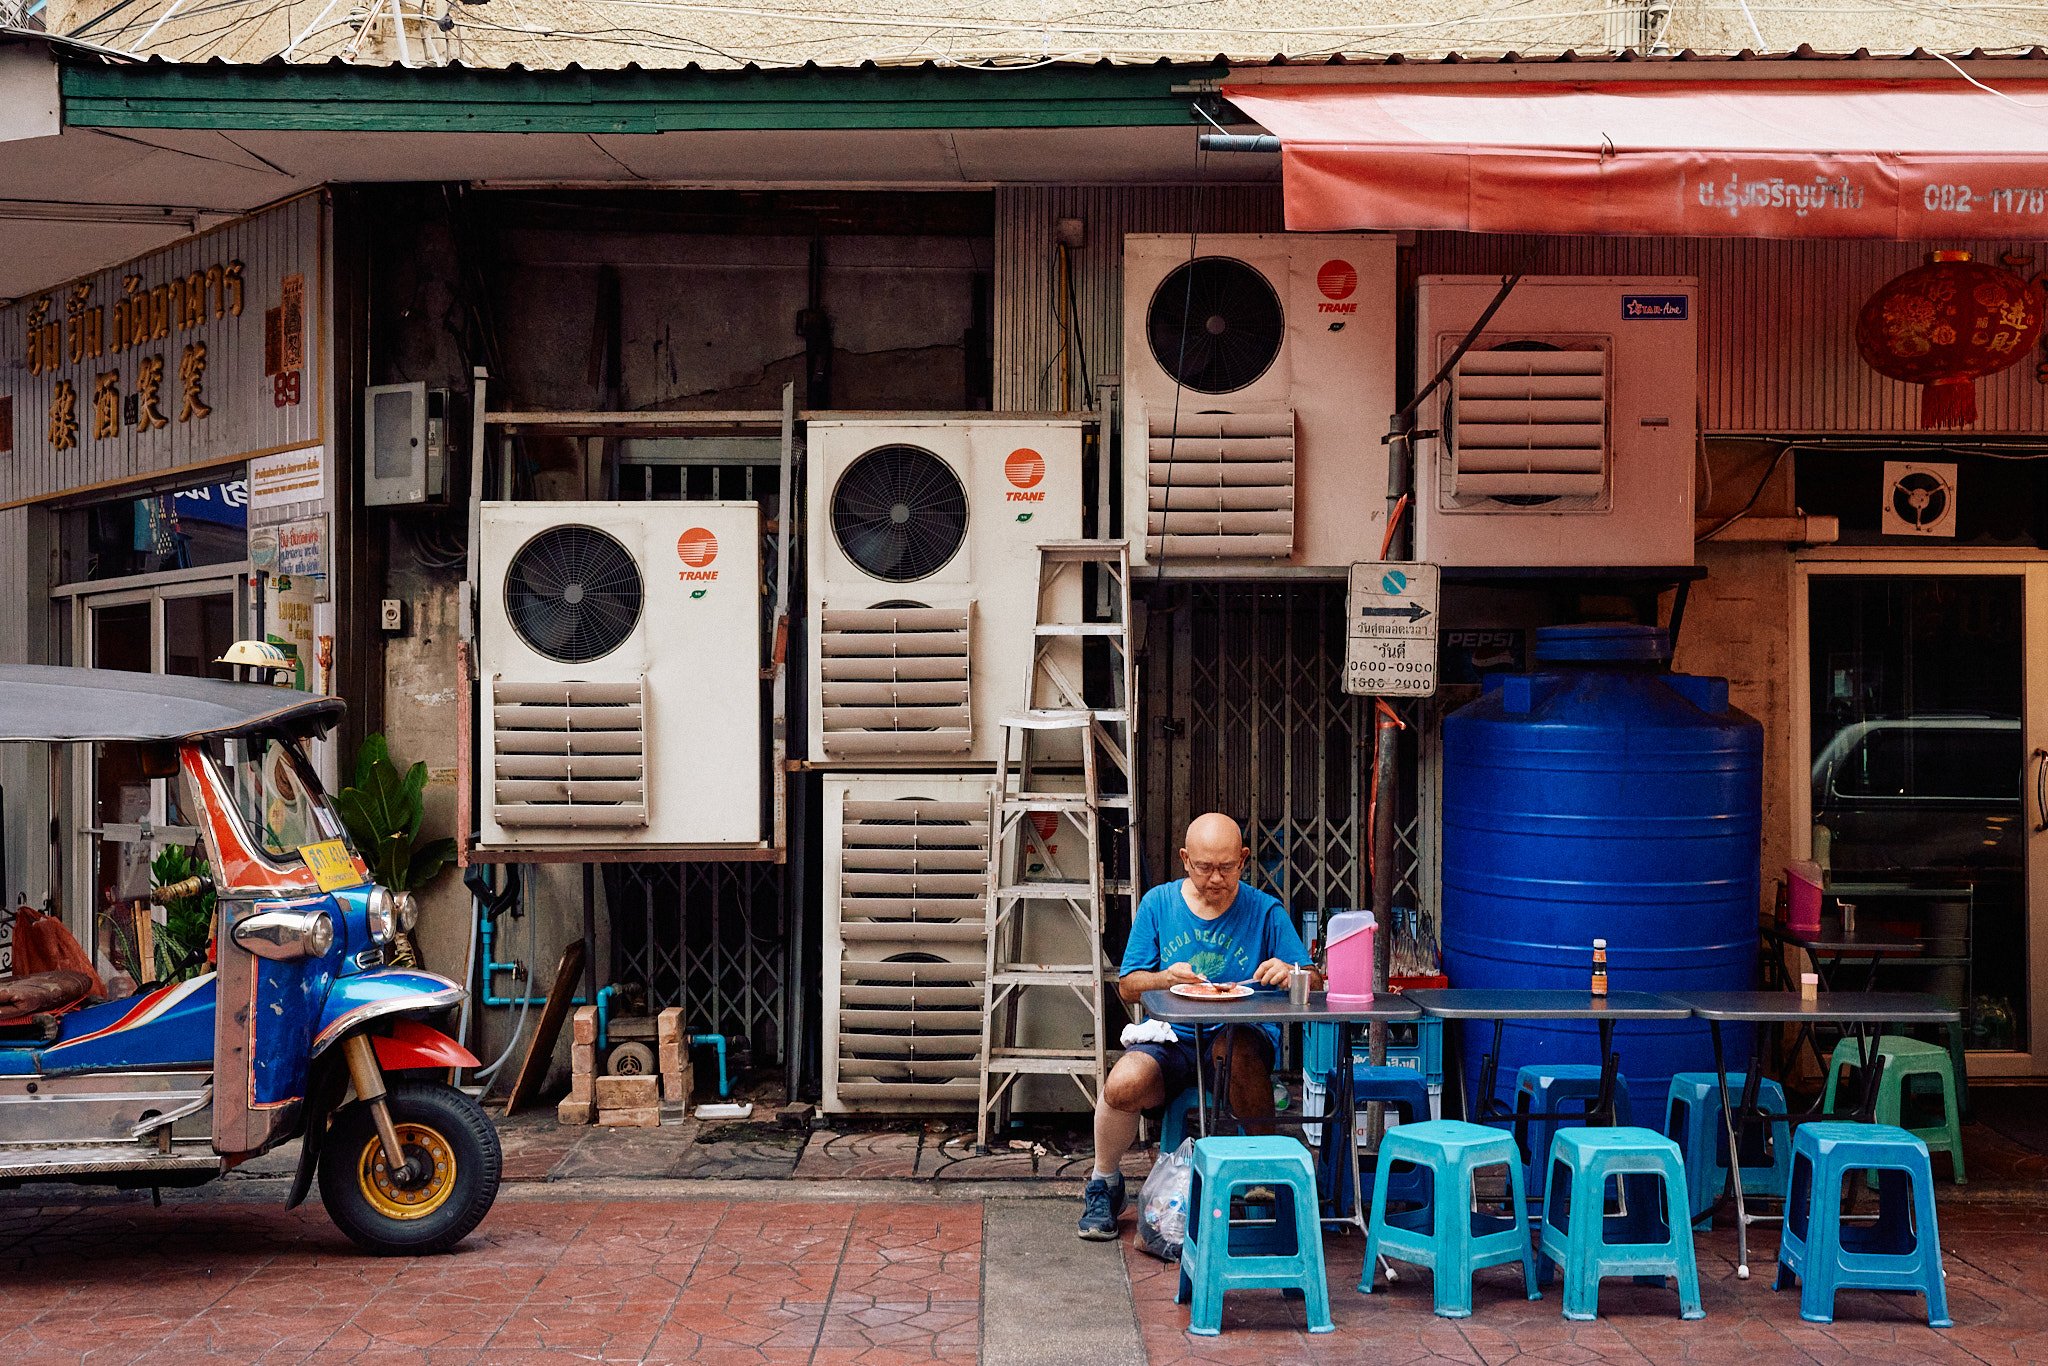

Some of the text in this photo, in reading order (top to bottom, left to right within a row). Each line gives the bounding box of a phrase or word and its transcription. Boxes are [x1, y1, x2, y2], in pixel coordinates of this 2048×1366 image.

[1923, 183, 2048, 215] 082-1178
[1317, 303, 1358, 313] TRANE
[273, 370, 301, 409] 89
[1005, 491, 1046, 502] TRANE
[678, 571, 719, 581] TRANE
[1447, 632, 1515, 648] PEPSI
[1350, 661, 1433, 674] 0600-0900
[1160, 931, 1192, 963] COCOA
[1194, 928, 1234, 950] BEACH
